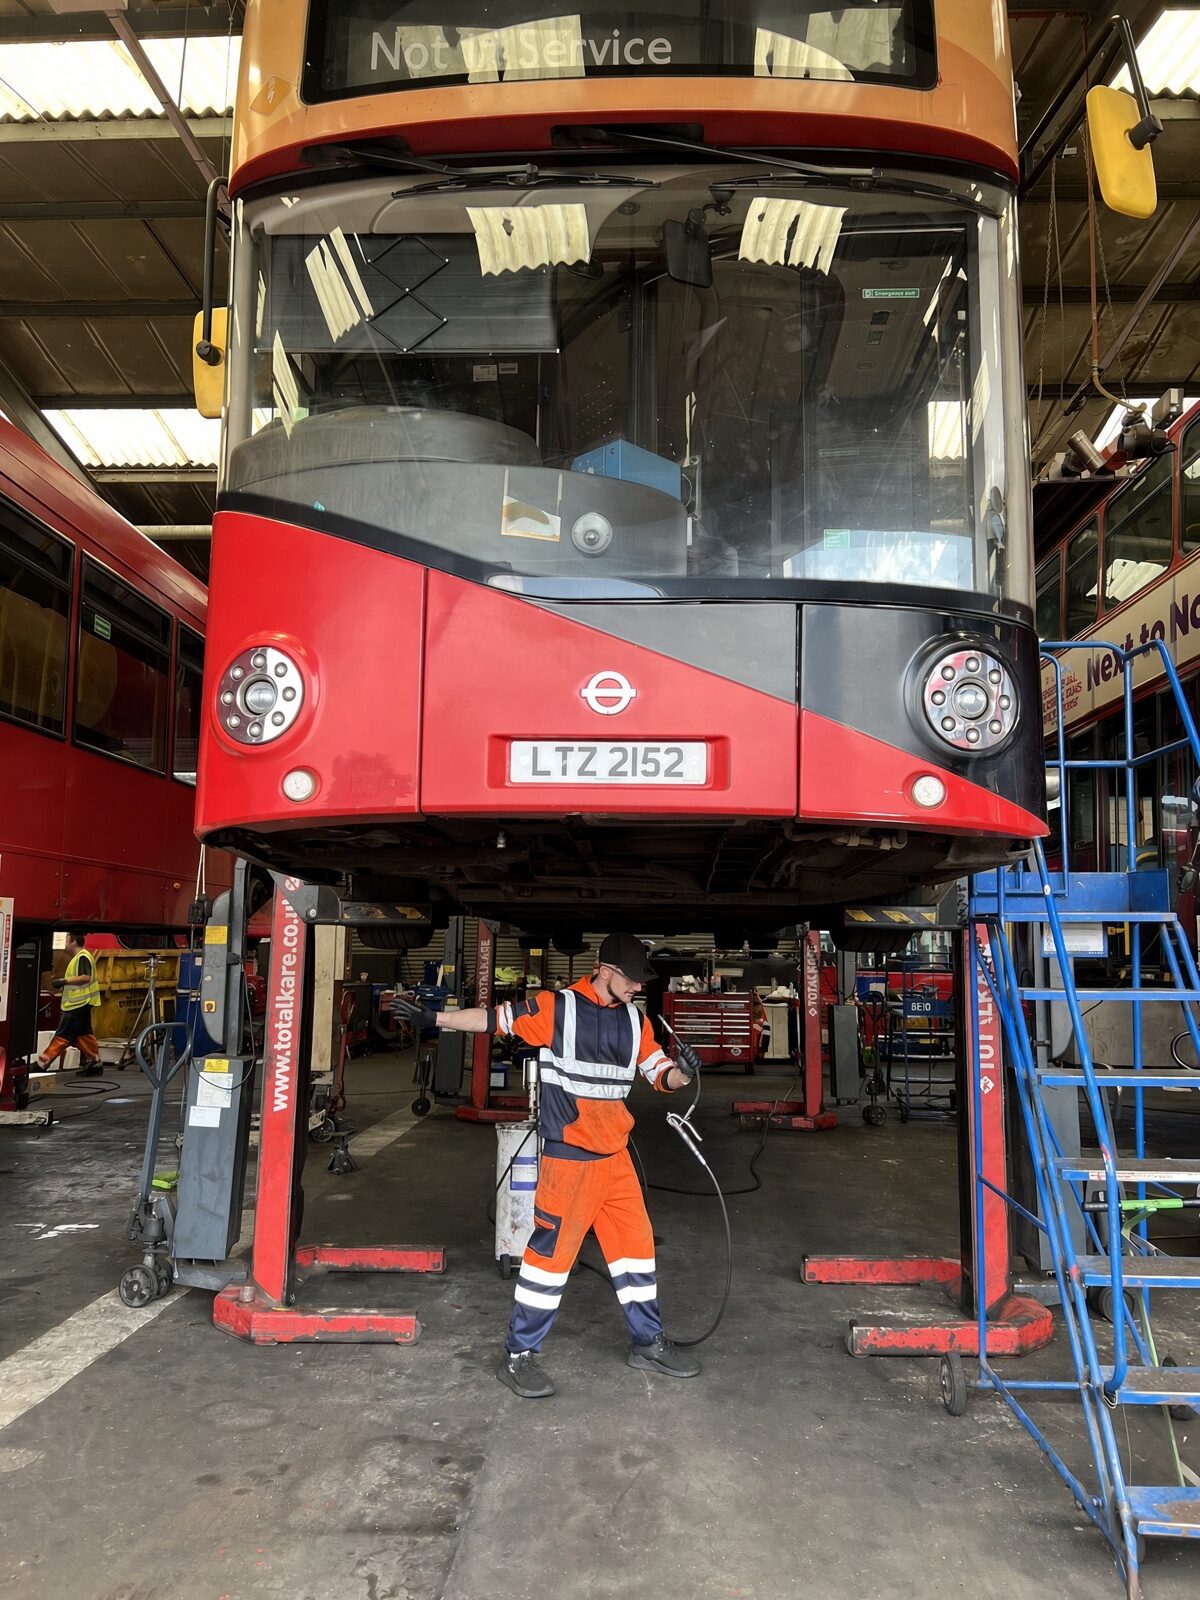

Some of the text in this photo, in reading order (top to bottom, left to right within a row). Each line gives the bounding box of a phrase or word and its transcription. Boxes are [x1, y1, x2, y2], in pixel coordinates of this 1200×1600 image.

[370, 30, 449, 71] Not
[518, 28, 672, 68] Service
[1139, 620, 1165, 657] to
[532, 746, 684, 778] LTZ 2152
[272, 898, 299, 1113] www.totalkare.co.u
